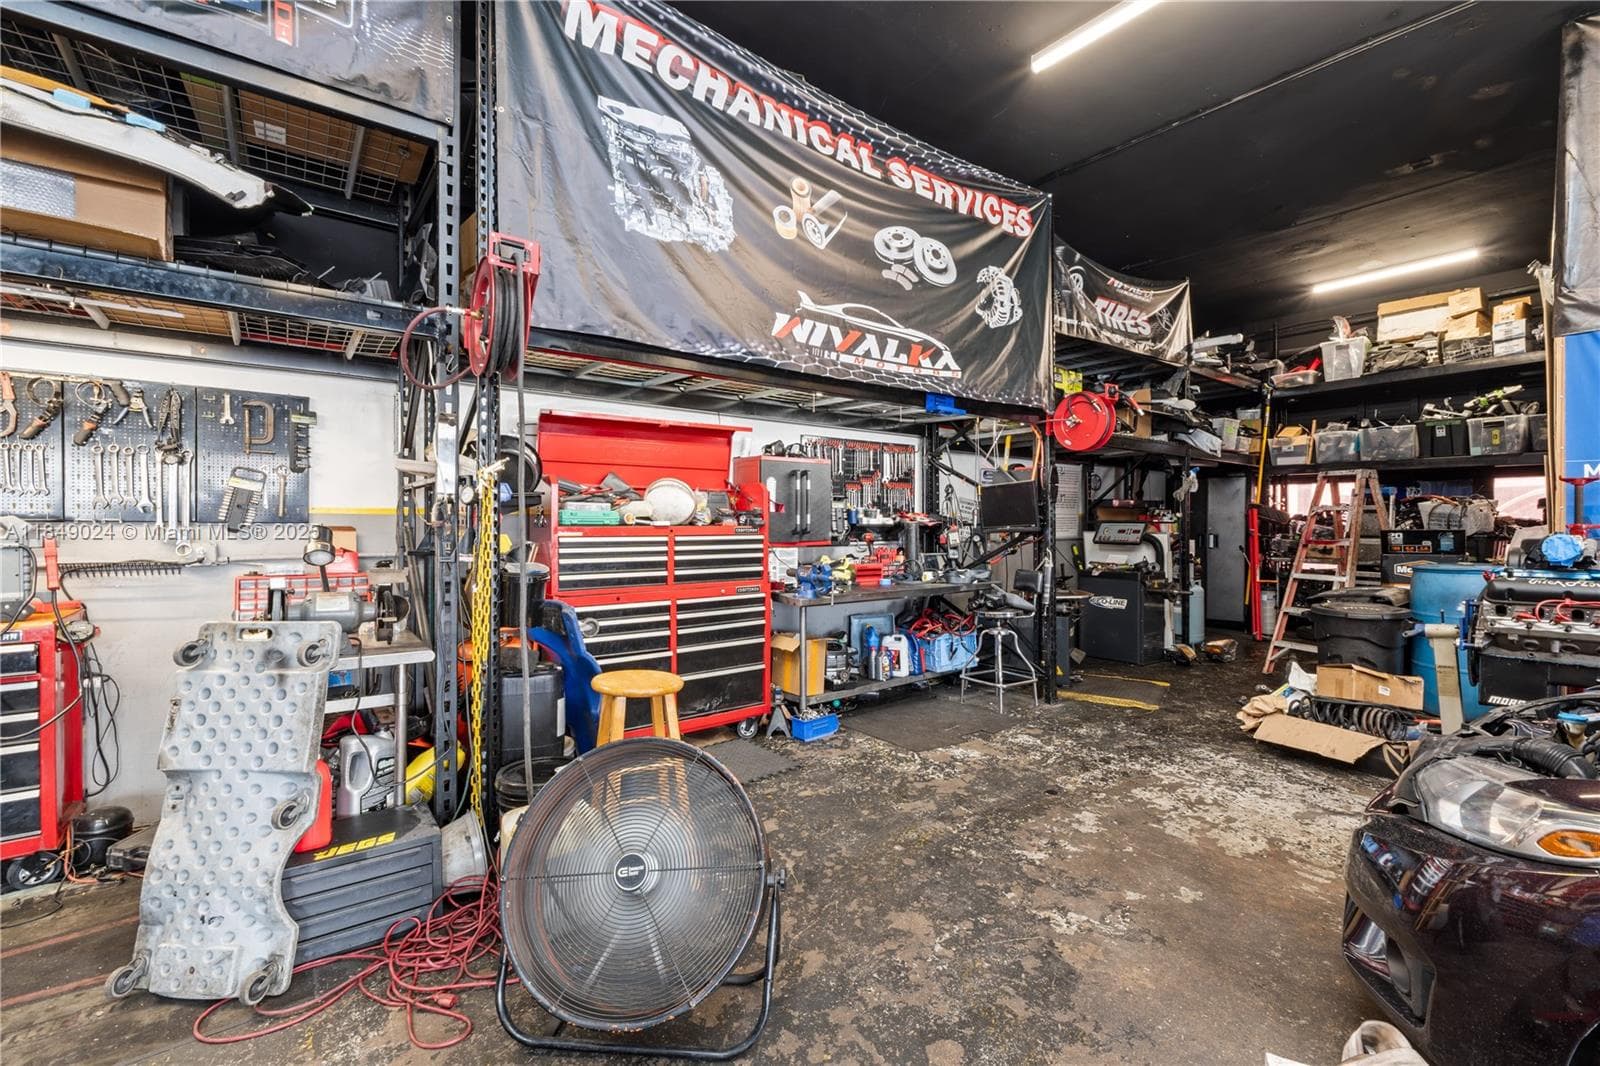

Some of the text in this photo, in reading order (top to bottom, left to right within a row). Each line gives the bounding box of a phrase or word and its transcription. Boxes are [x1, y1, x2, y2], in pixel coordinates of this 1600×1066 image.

[564, 0, 1034, 238] MECHANICAL SERVICES
[1094, 296, 1152, 337] TIRES
[853, 356, 961, 378] MOTORS
